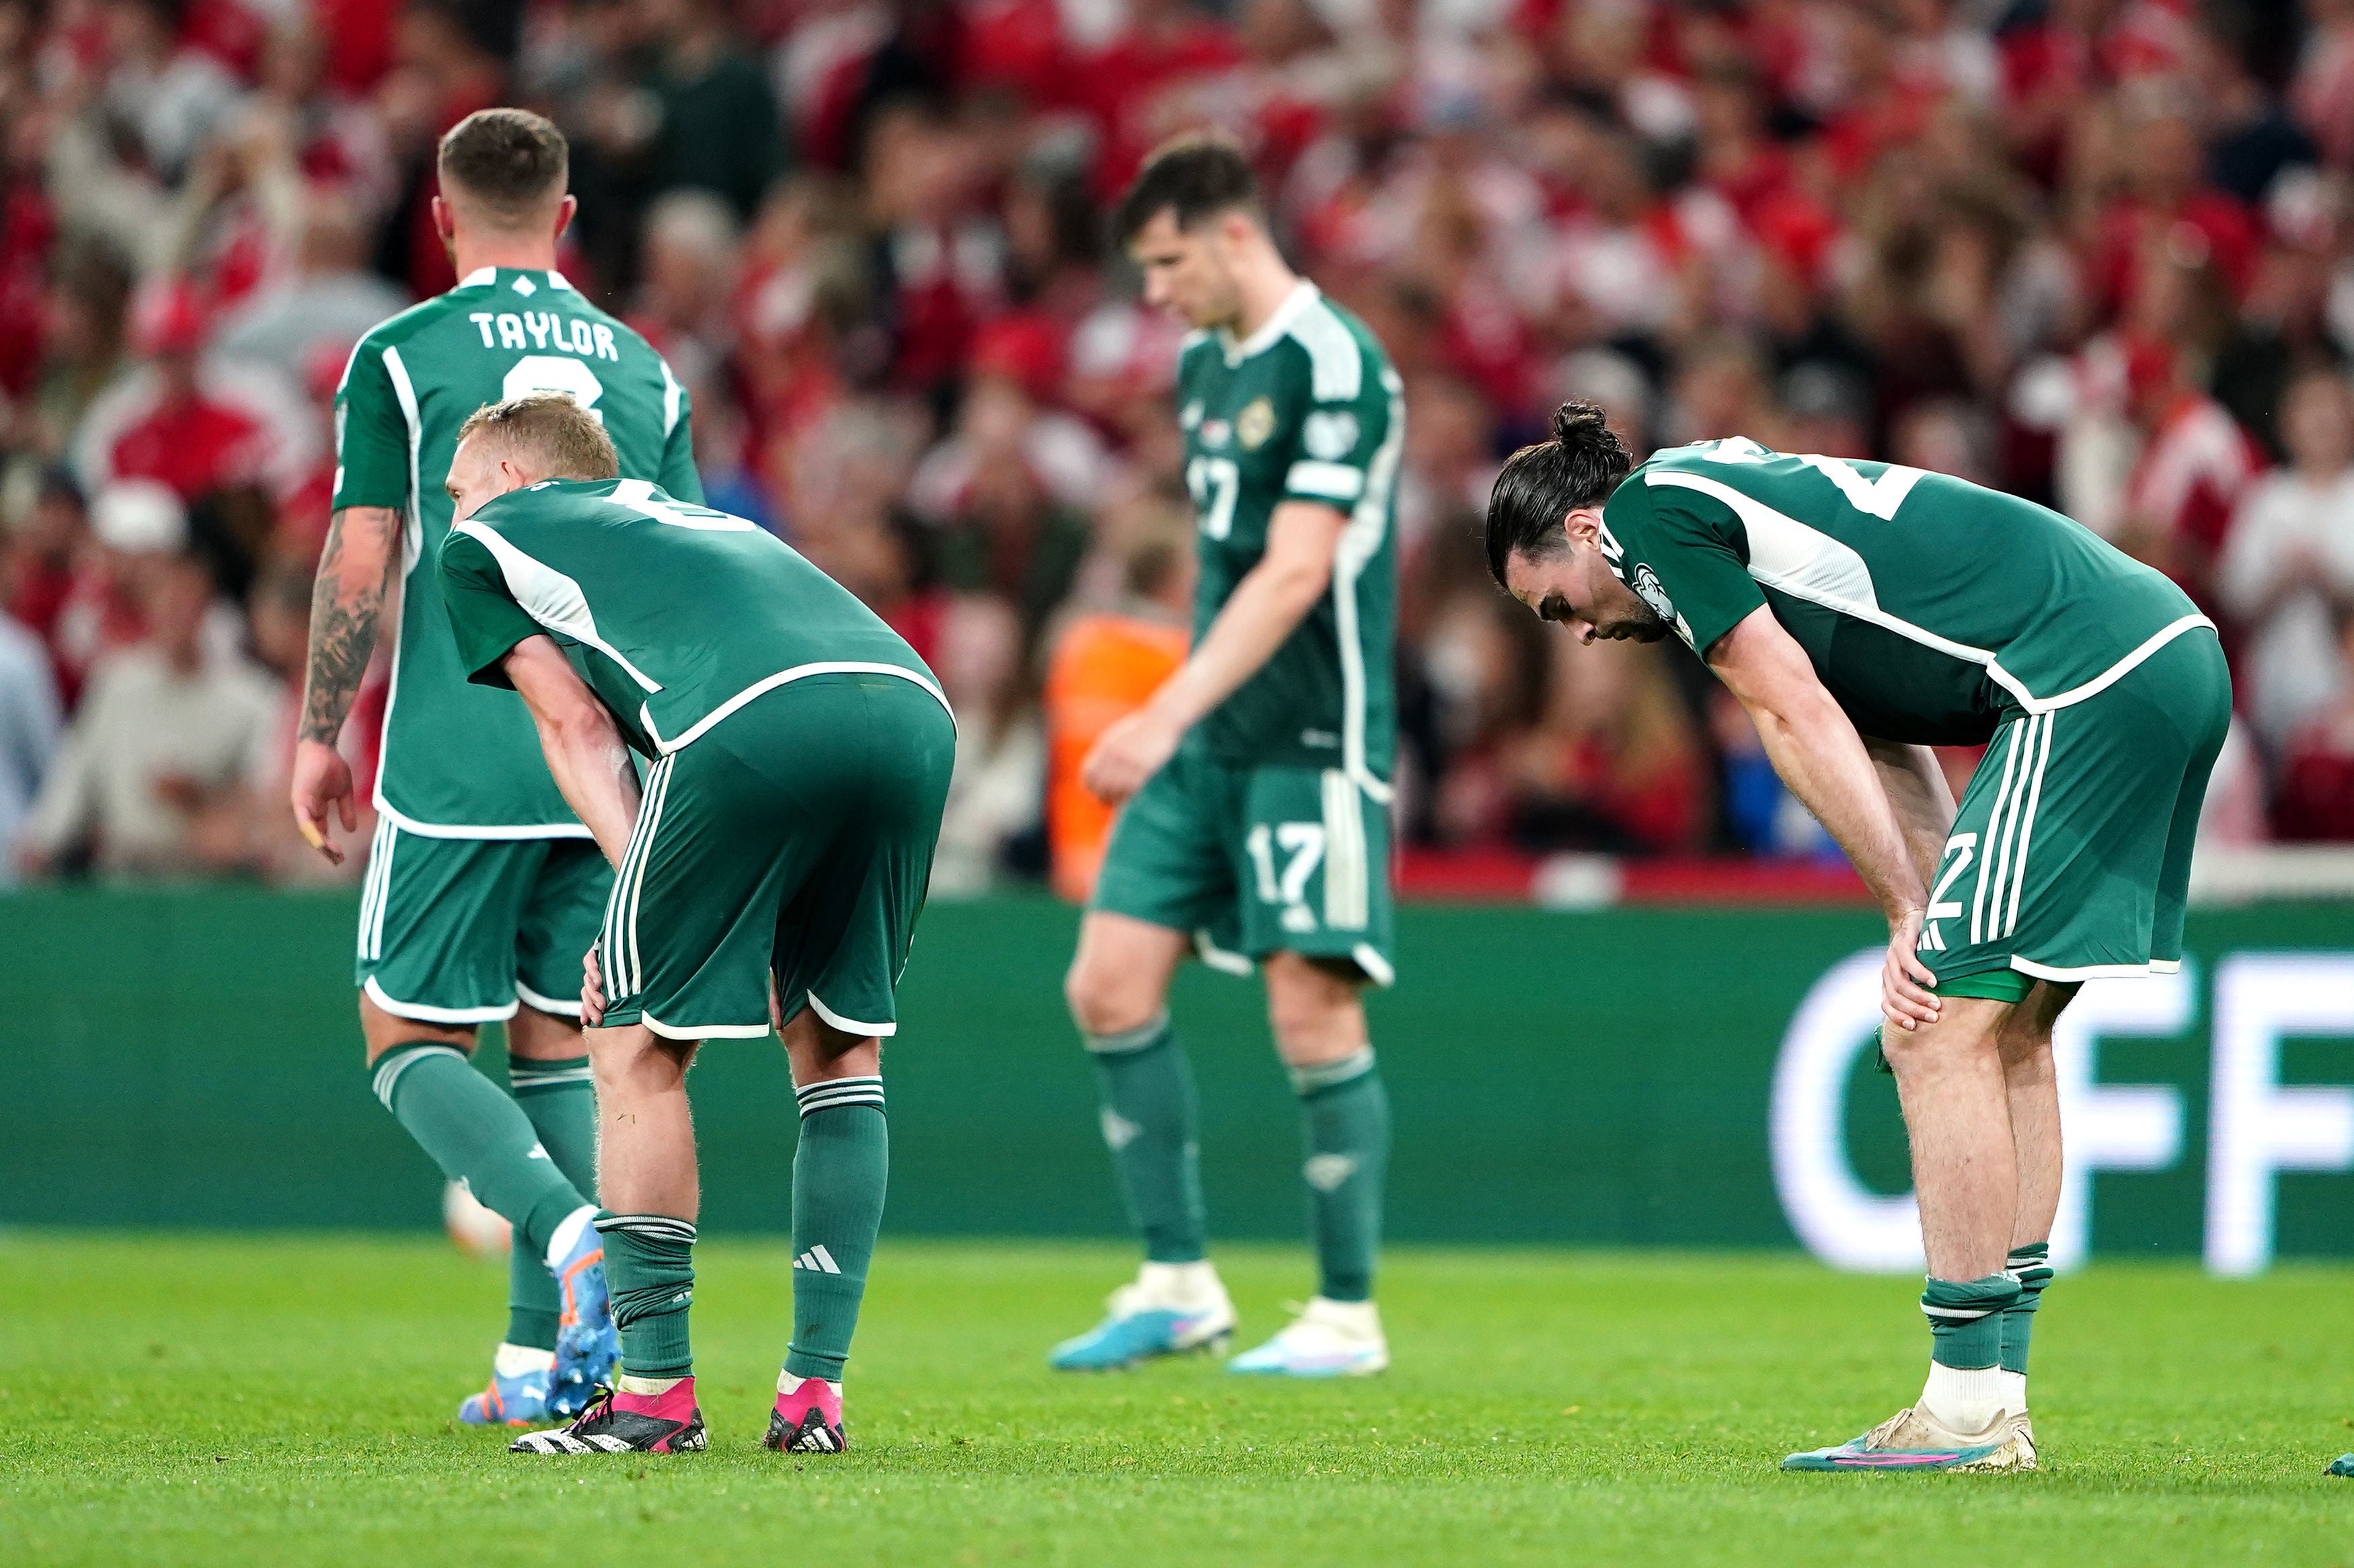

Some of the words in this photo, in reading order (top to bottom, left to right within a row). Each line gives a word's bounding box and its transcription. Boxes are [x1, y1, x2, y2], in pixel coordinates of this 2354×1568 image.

[469, 310, 619, 362] TAYLOR
[1247, 821, 1324, 904] 17
[1925, 832, 1977, 920] 2
[1770, 943, 2354, 1279] OFF
